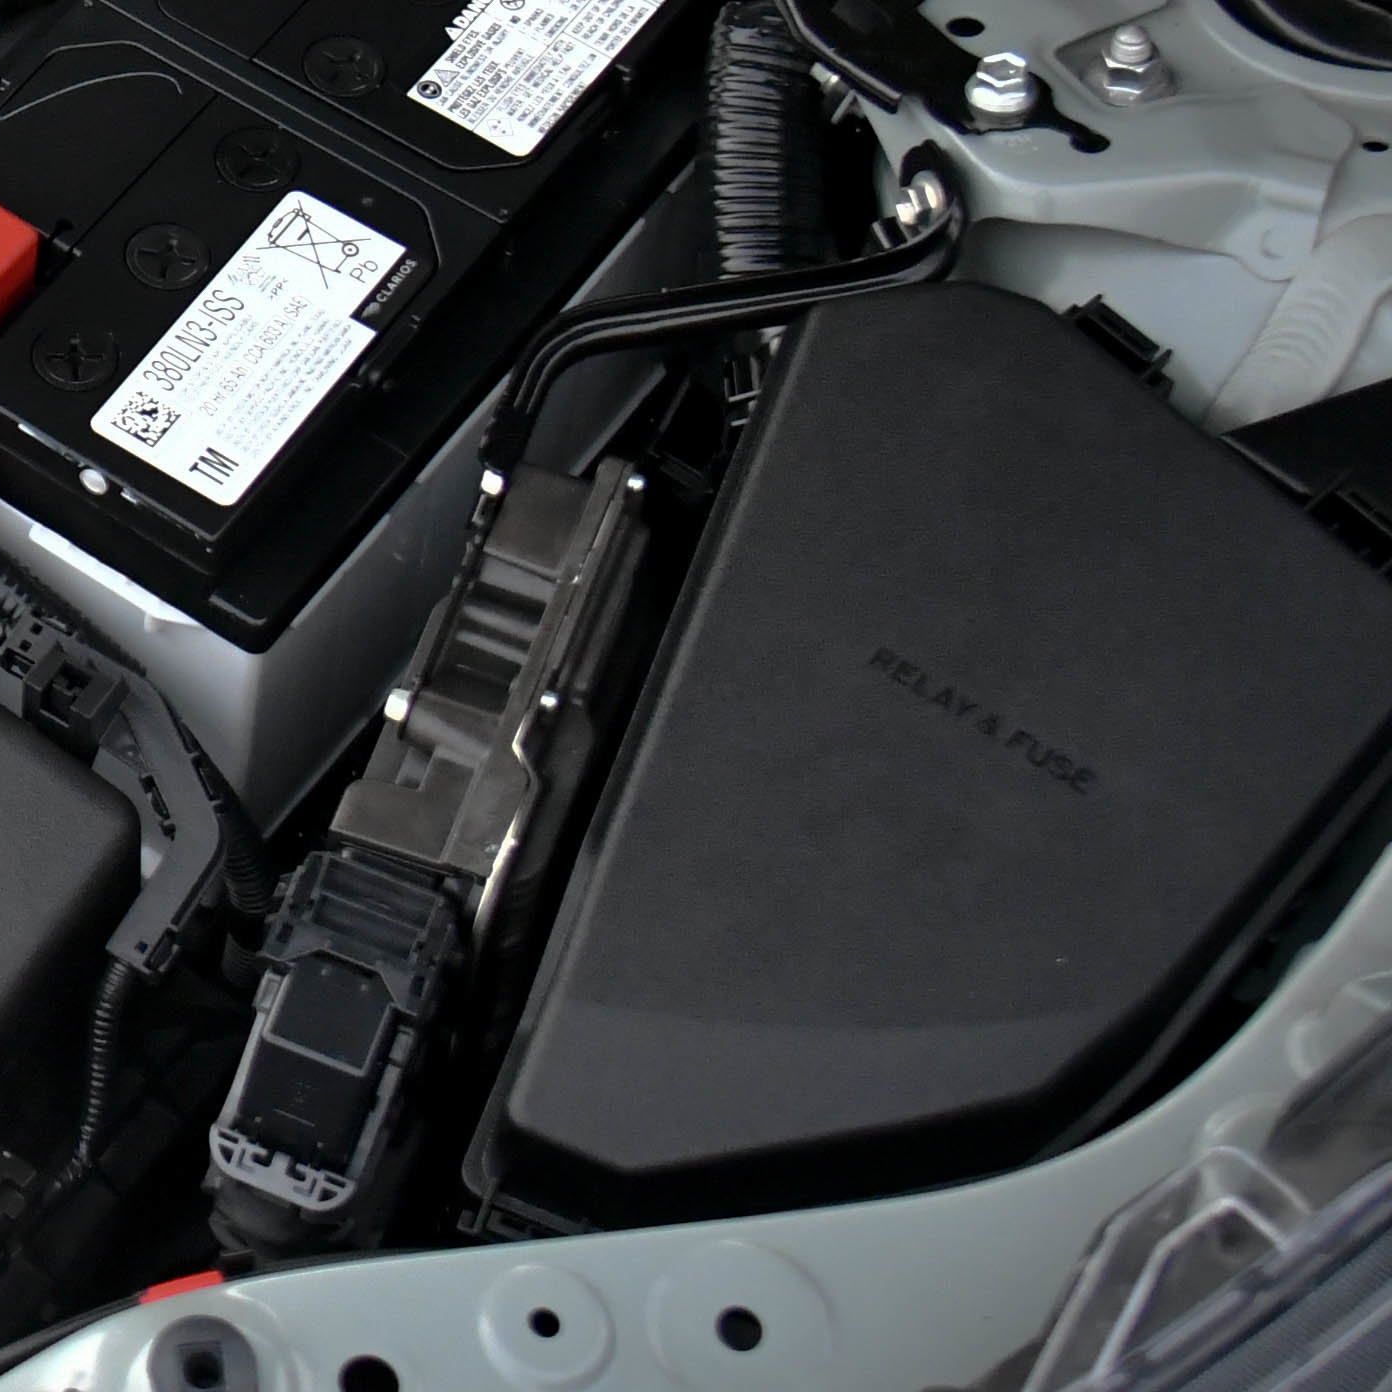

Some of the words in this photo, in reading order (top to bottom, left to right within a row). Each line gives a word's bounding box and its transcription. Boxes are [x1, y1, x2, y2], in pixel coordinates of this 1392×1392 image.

[349, 258, 379, 285] Pb
[375, 258, 418, 304] CLARIOS
[143, 288, 245, 392] 380LN3-ISS
[242, 341, 267, 365] CCA
[189, 446, 240, 486] TM
[868, 646, 978, 718] RELAY
[1005, 728, 1098, 796] FUSE
